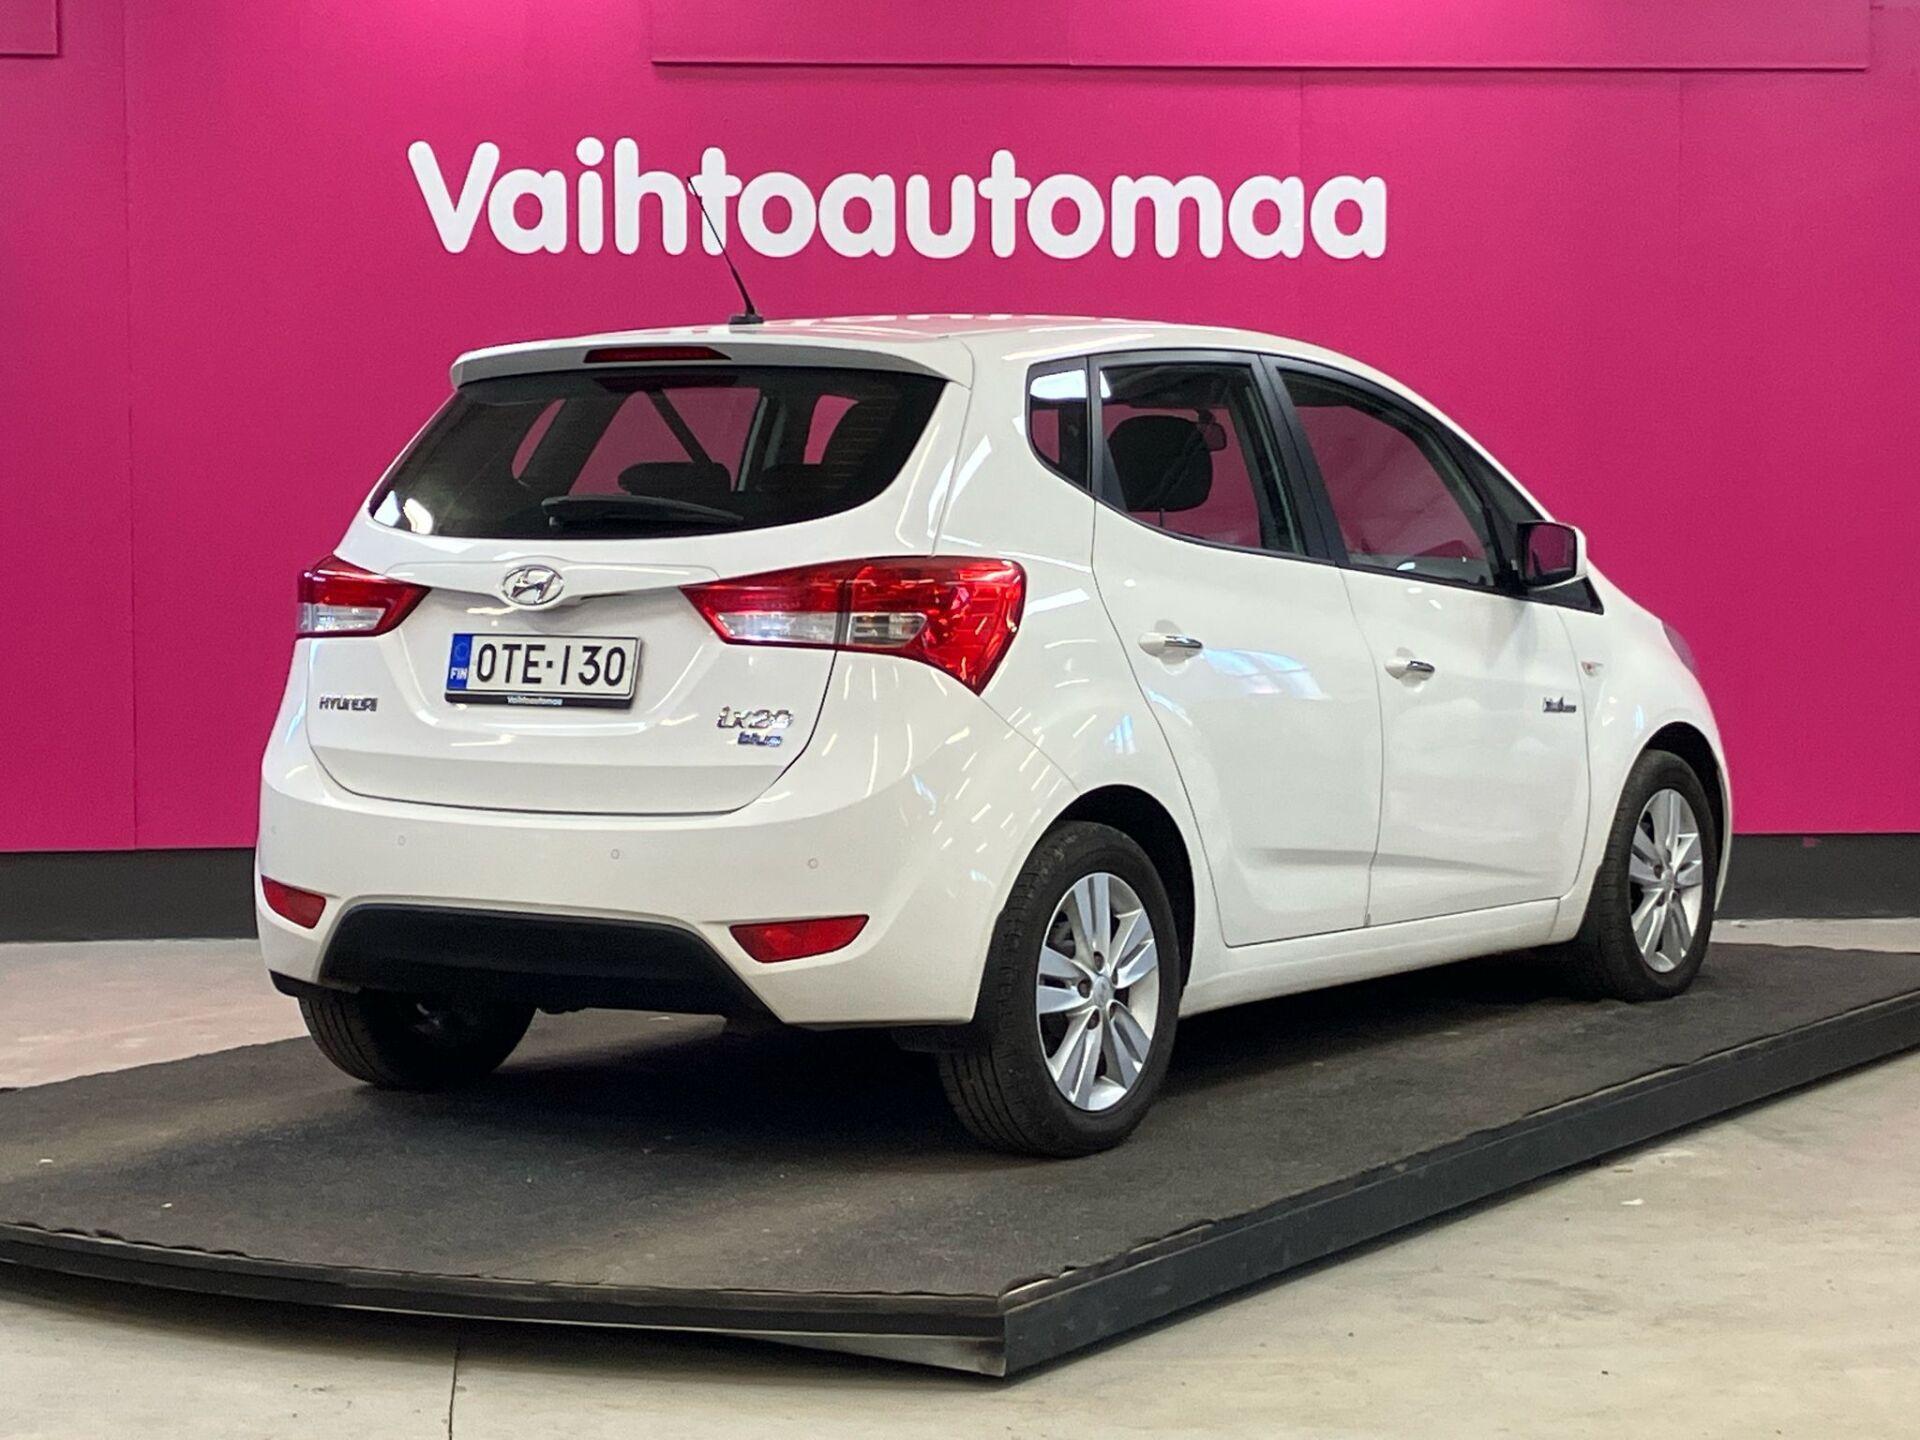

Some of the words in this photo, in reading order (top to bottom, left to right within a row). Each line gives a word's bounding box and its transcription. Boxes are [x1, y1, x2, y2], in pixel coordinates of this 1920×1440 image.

[407, 136, 1388, 260] Vaihtoautomaa
[450, 667, 469, 681] FIN
[476, 643, 626, 687] OTE-130
